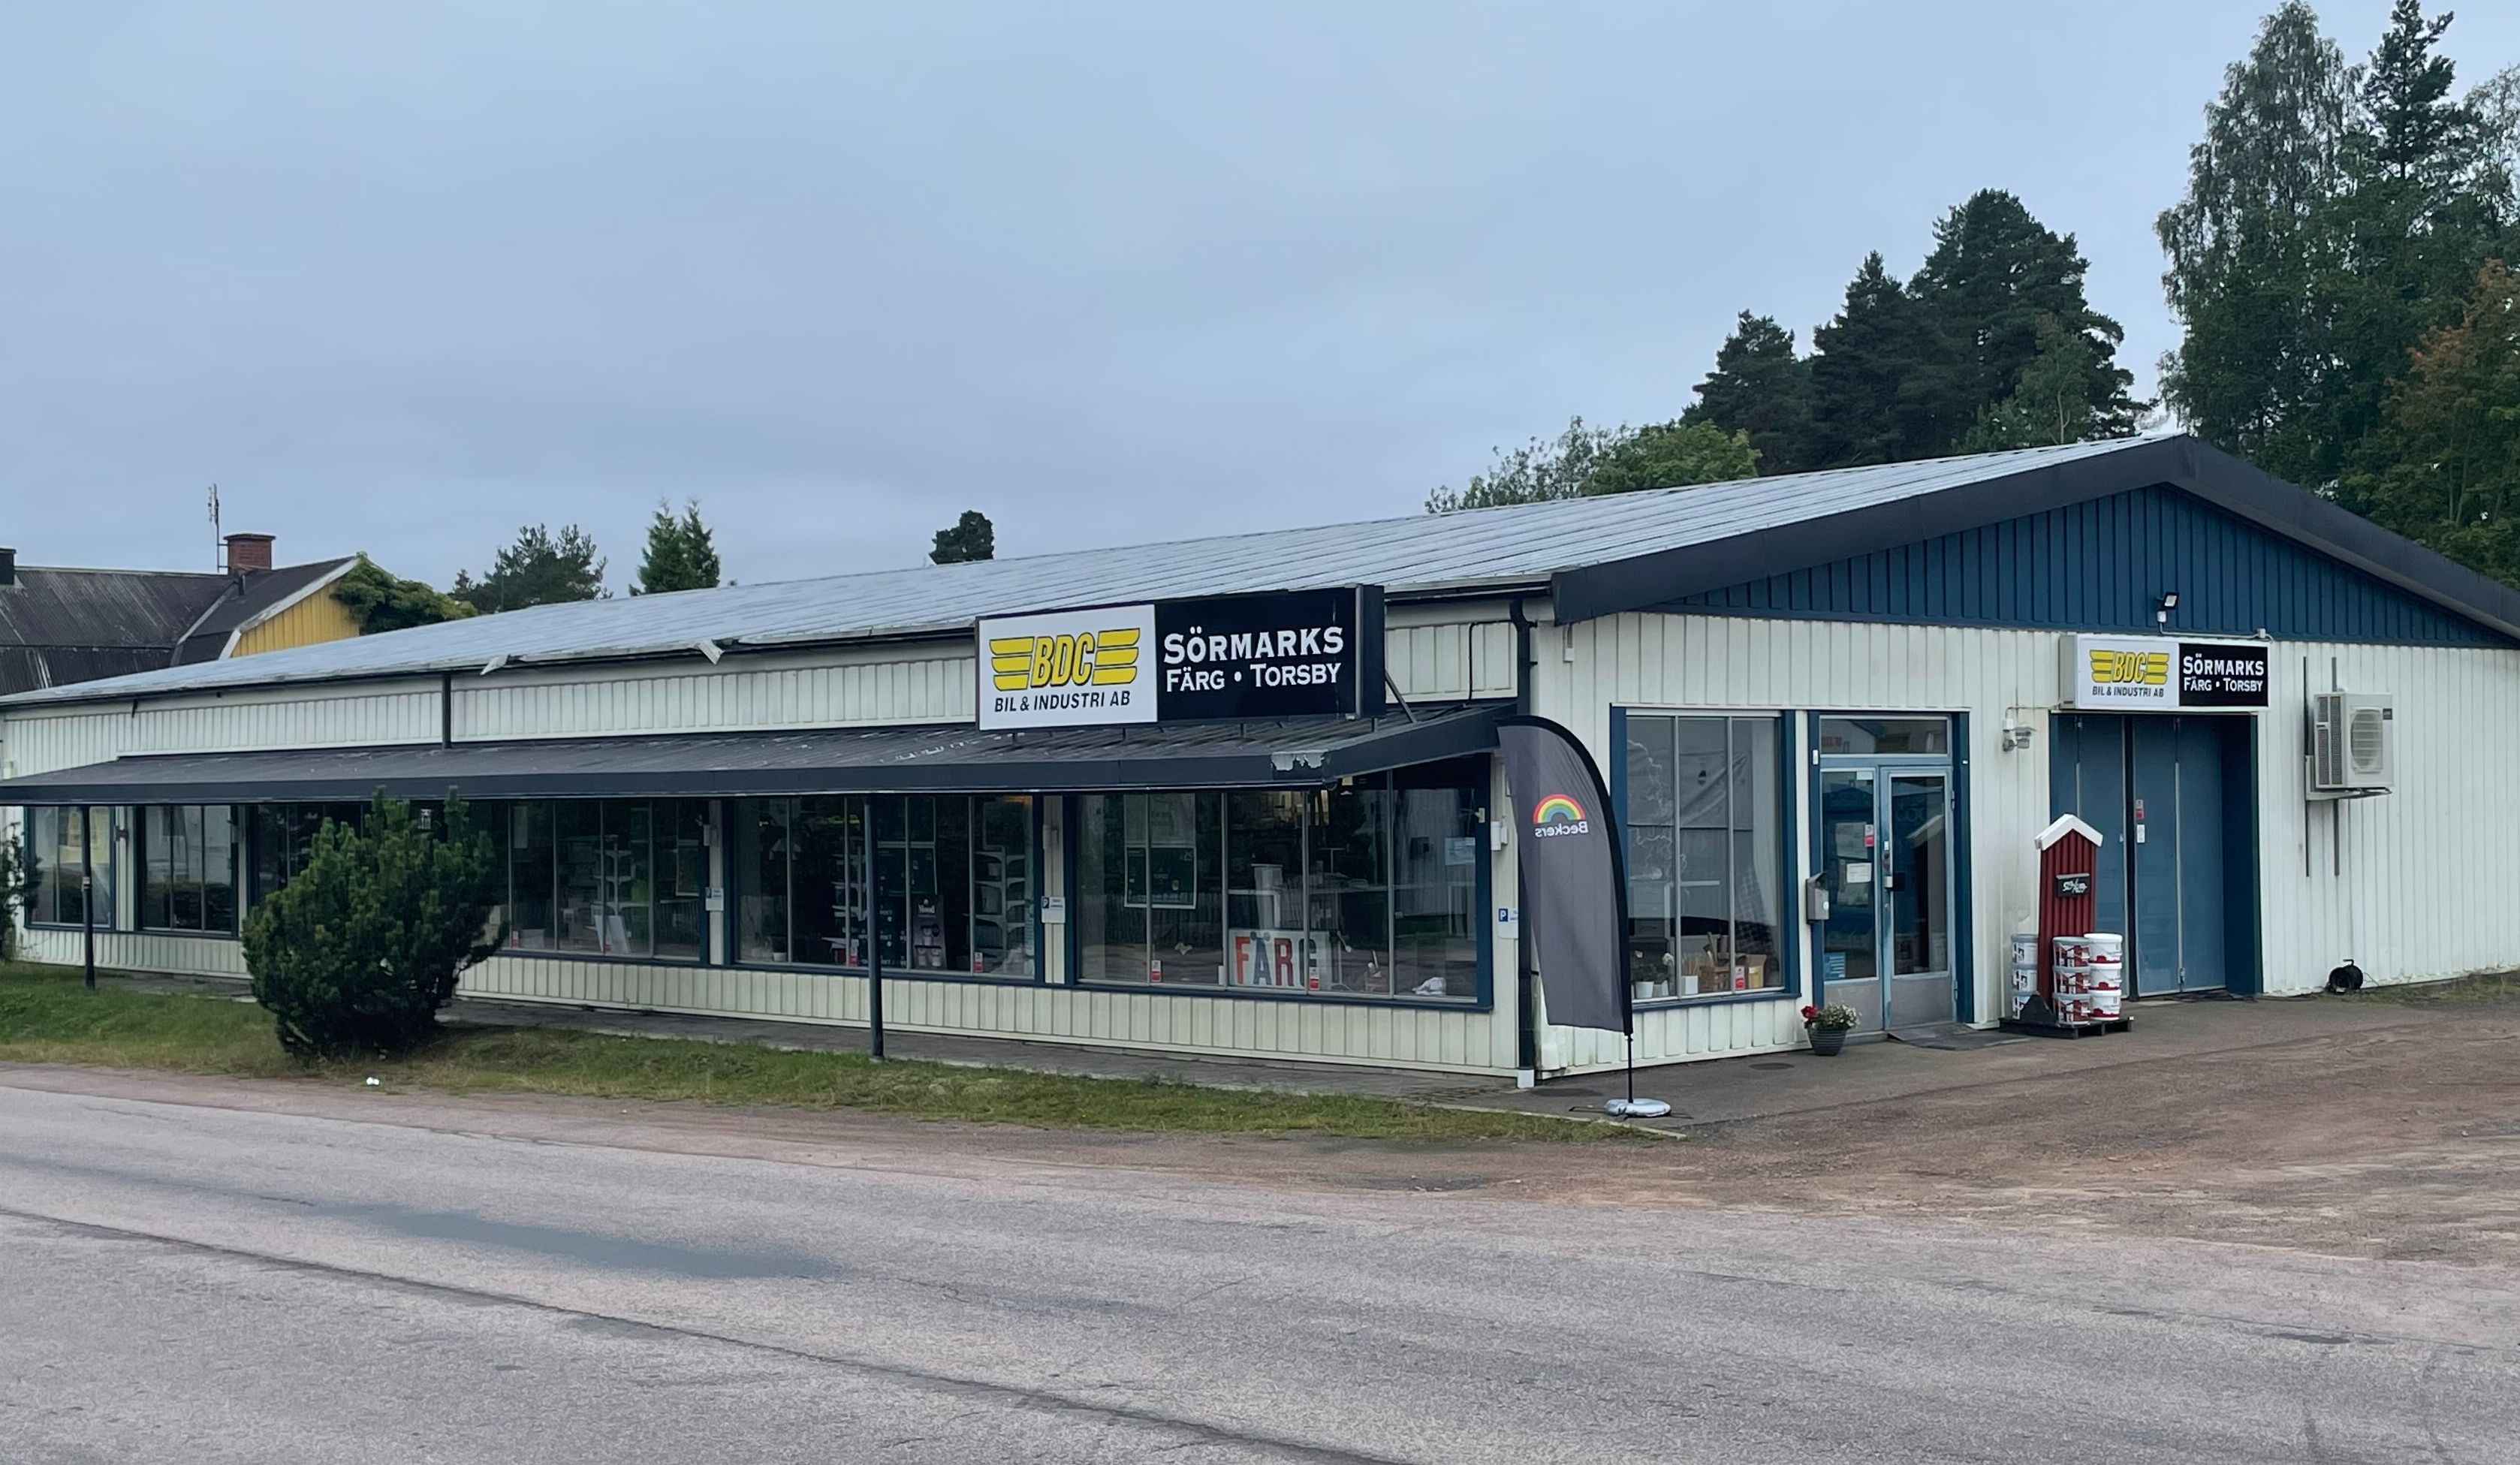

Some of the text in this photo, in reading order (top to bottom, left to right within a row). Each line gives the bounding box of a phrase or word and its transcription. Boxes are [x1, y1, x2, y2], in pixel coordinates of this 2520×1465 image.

[1163, 626, 1344, 664] SÖRMARKS
[1030, 632, 1096, 688] BDC
[2112, 651, 2146, 684] BDC
[2183, 653, 2264, 676] SÖRMARKS
[1166, 662, 1342, 692] FÄRG TORSBY
[2184, 676, 2263, 692] FÄRG TORSBY
[994, 690, 1130, 713] BIL & INDUSTRI AB
[2092, 686, 2164, 698] BIL & INDUSTRI AB
[1500, 909, 1506, 921] P
